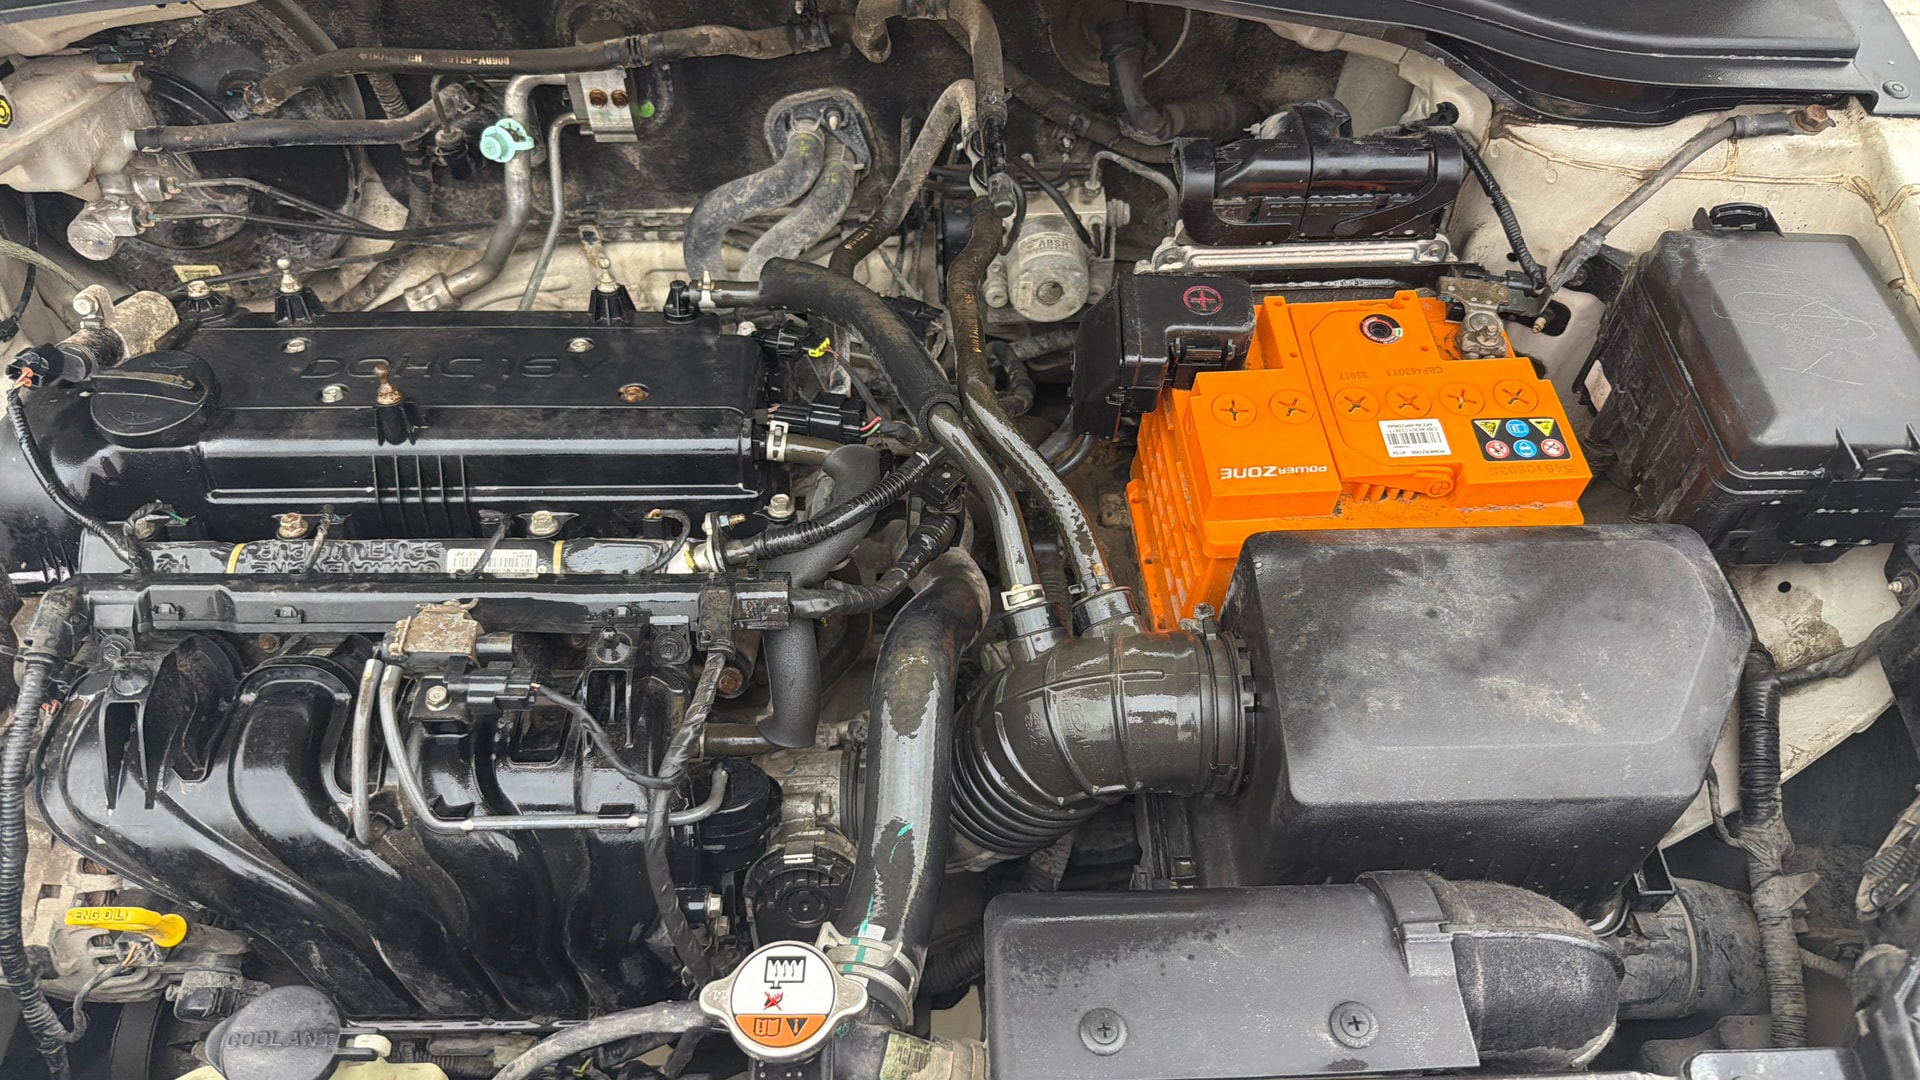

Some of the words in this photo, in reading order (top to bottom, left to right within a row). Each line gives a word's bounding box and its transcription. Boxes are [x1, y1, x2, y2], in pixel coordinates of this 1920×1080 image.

[300, 356, 485, 379] DOHC
[1220, 465, 1328, 480] POWERZONE
[74, 909, 100, 921] ENG
[226, 1029, 339, 1047] COOLANT
